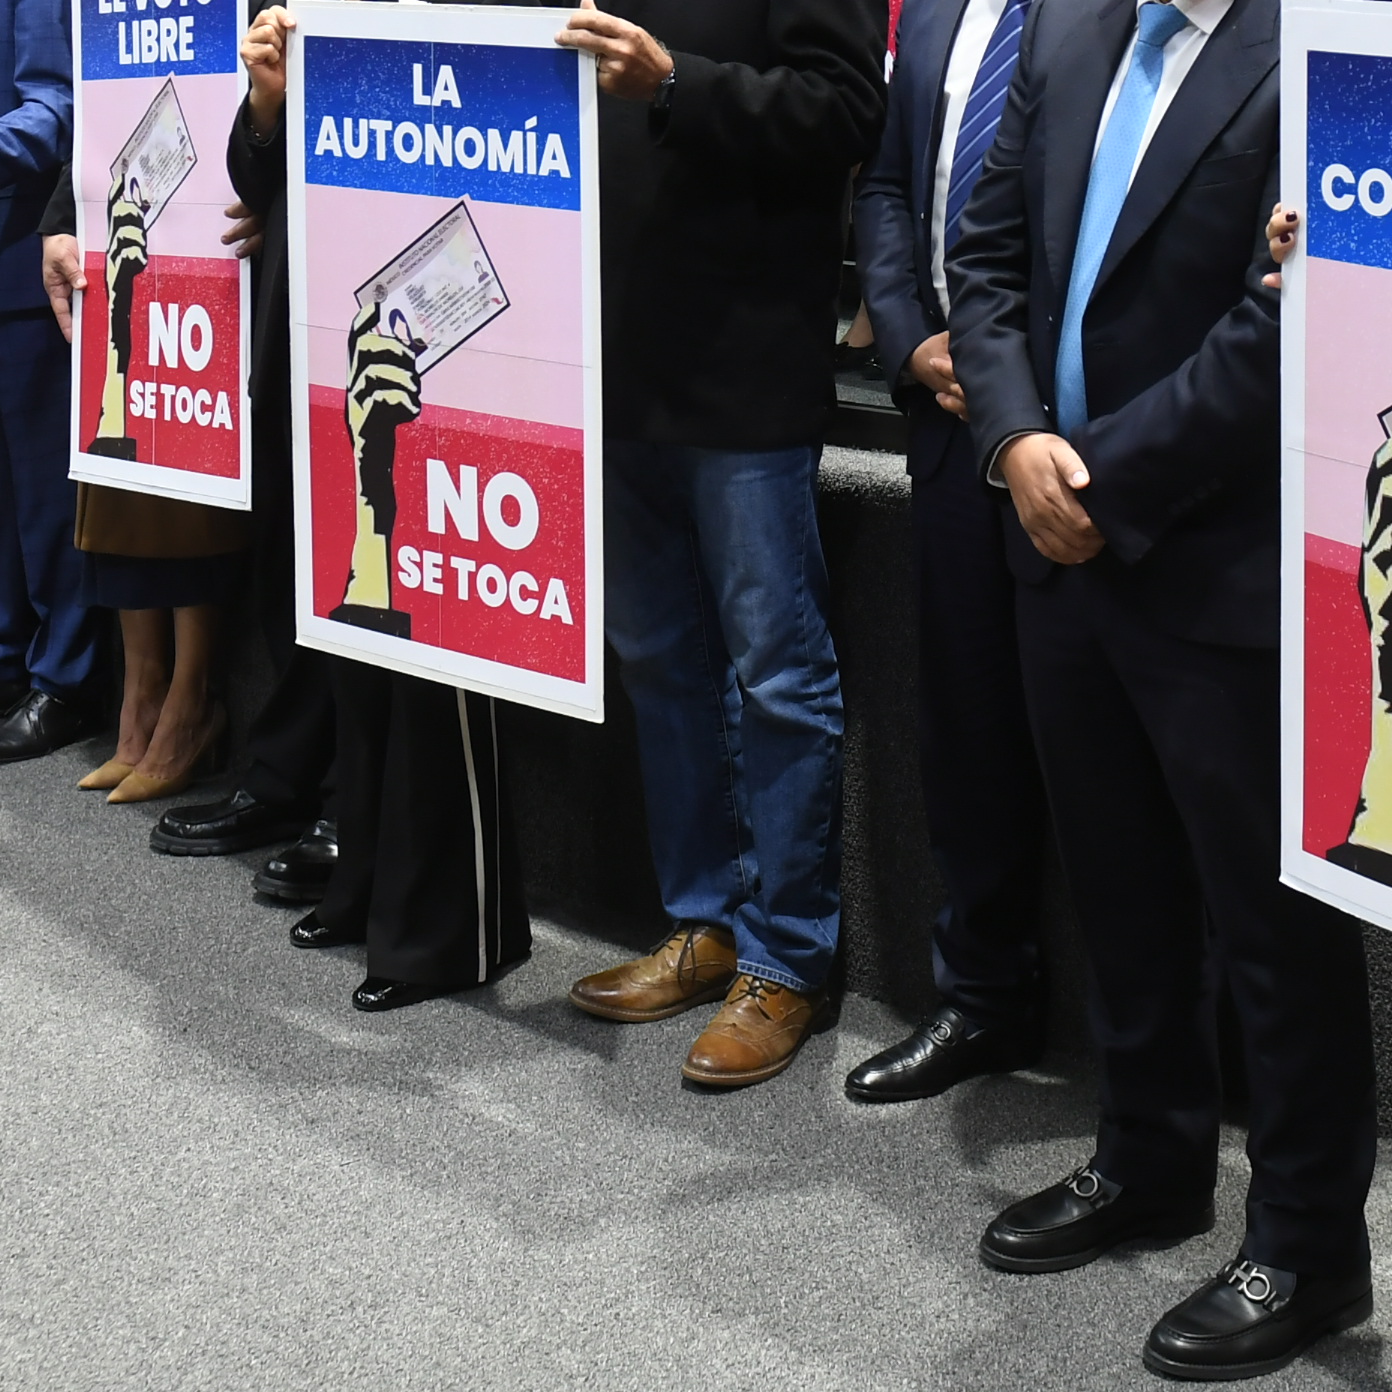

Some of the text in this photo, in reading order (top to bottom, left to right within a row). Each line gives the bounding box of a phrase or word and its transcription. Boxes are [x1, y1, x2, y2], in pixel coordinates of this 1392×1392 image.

[119, 16, 194, 64] LIBRE
[413, 64, 461, 108] LA
[315, 116, 570, 177] AUTONOMÍA
[149, 302, 213, 371] NO
[129, 384, 233, 430] SE TOCA
[427, 459, 539, 550] NO
[398, 546, 573, 624] SE TOCA
